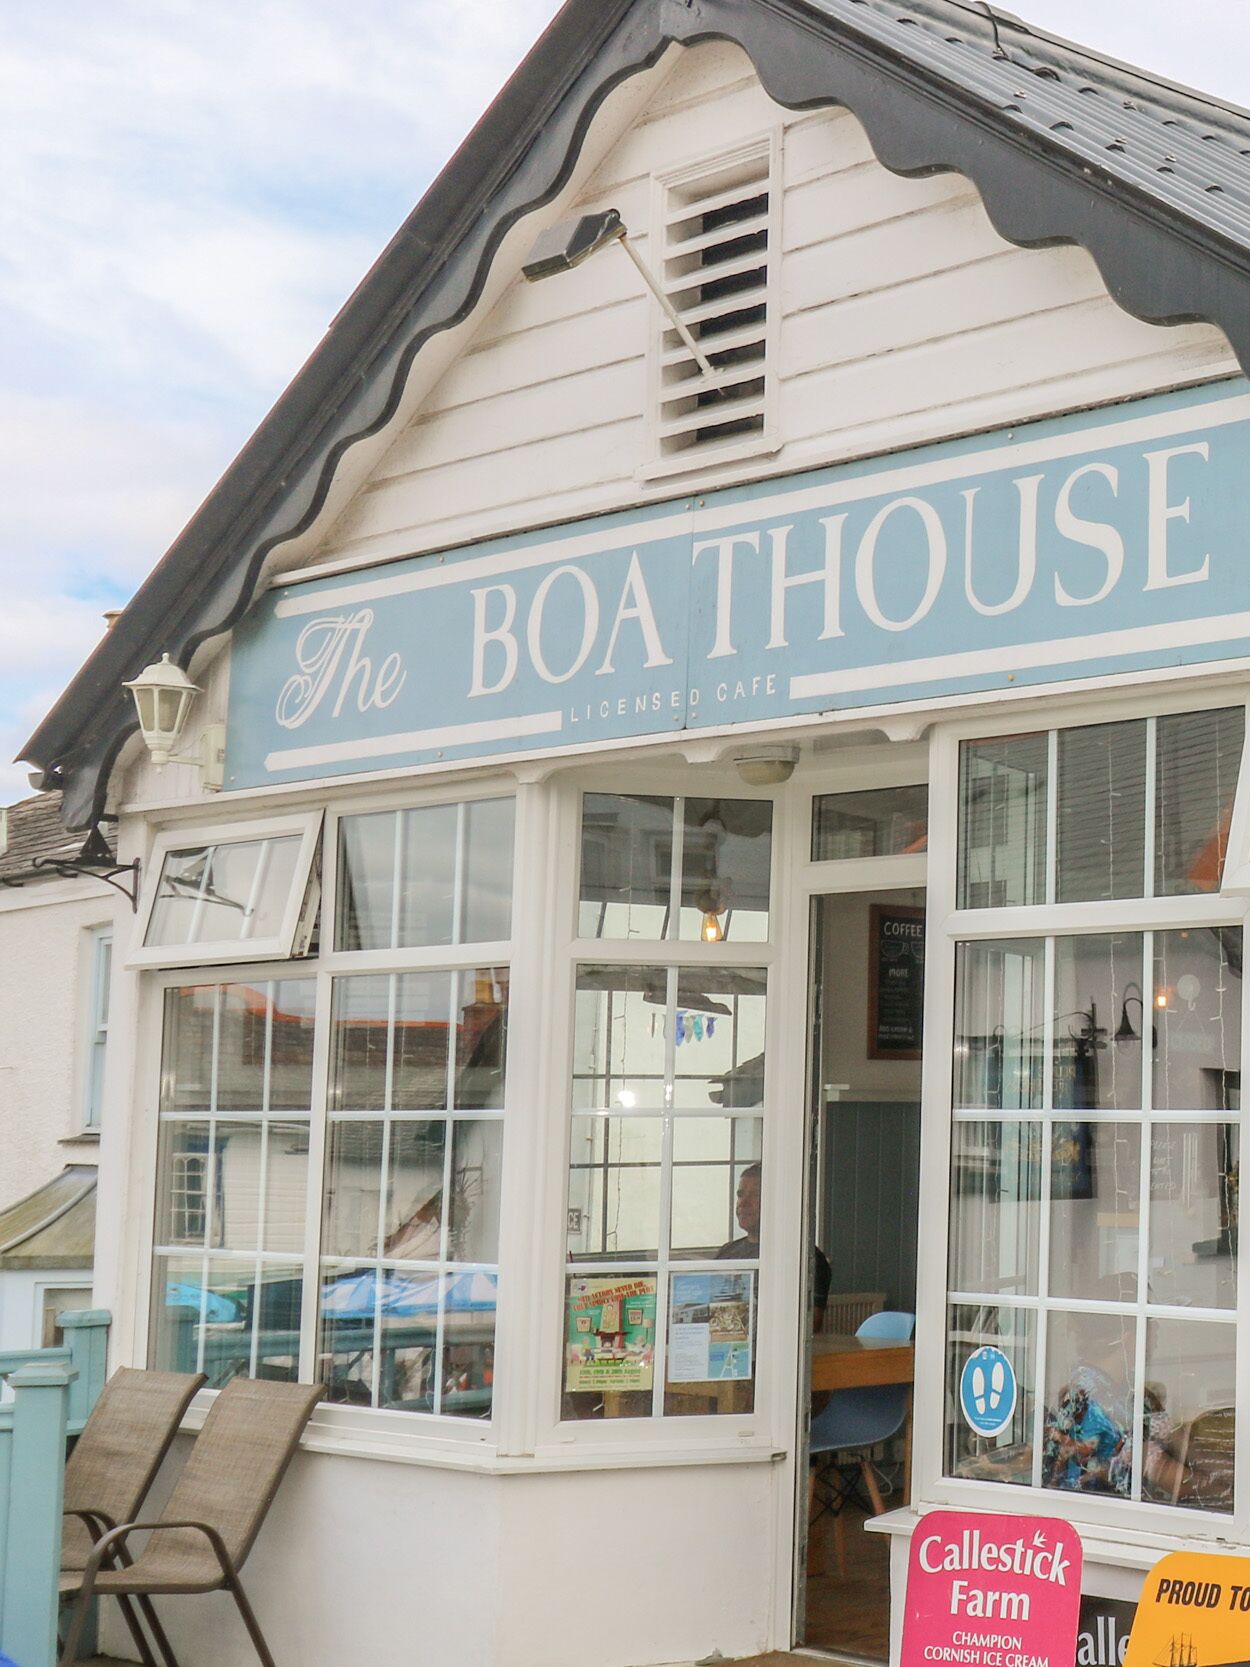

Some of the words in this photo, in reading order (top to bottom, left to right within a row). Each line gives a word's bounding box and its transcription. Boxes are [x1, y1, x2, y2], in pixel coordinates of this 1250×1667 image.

[275, 608, 407, 730] The
[466, 441, 1212, 699] BOATHOUSE
[570, 688, 700, 723] LICENSED
[716, 673, 777, 702] CAFE
[883, 921, 923, 937] COFFEE
[919, 1529, 1071, 1586] Callestick
[950, 1580, 1031, 1622] Farm
[1155, 1578, 1222, 1609] PROUD
[924, 1645, 981, 1664] CORNISH
[983, 1651, 1003, 1667] ICE
[1005, 1653, 1049, 1667] CREAM
[952, 1630, 1022, 1651] CHAMPION
